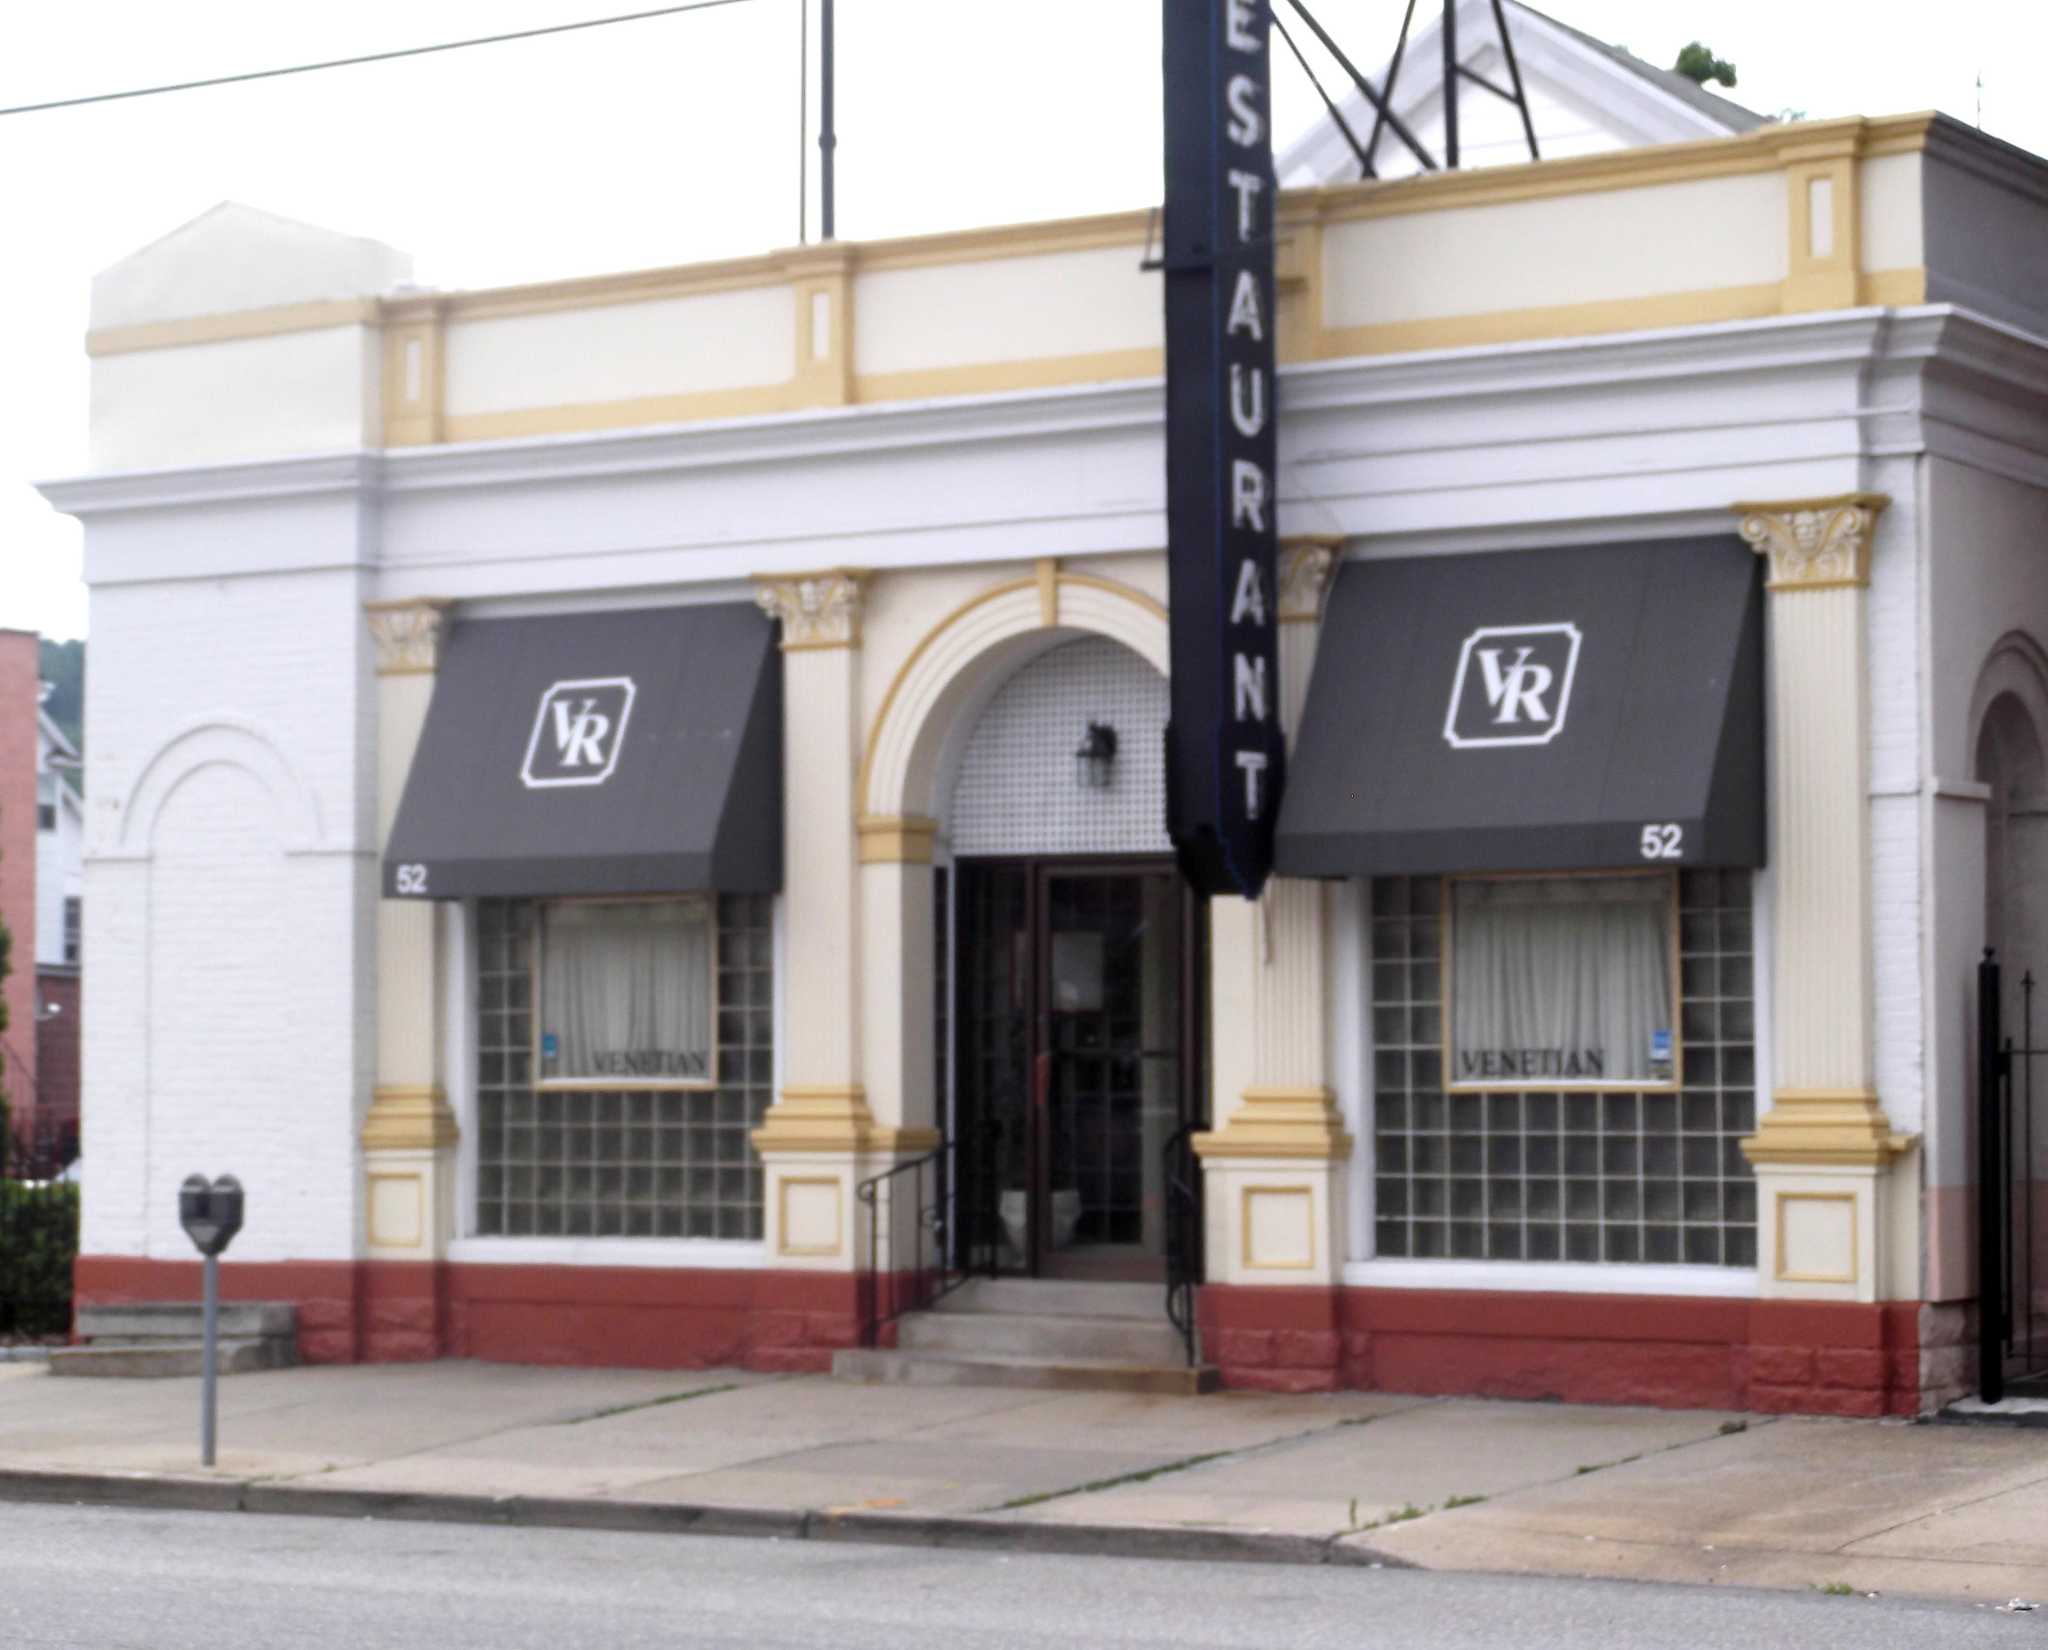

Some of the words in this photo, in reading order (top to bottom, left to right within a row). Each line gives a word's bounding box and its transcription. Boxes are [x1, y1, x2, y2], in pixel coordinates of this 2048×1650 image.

[1226, 0, 1268, 821] ESTAURANT
[1476, 646, 1554, 724] VR
[553, 698, 610, 766] VR
[1641, 824, 1682, 858] 52
[396, 864, 428, 894] 52
[1460, 1048, 1605, 1077] VENETIAN
